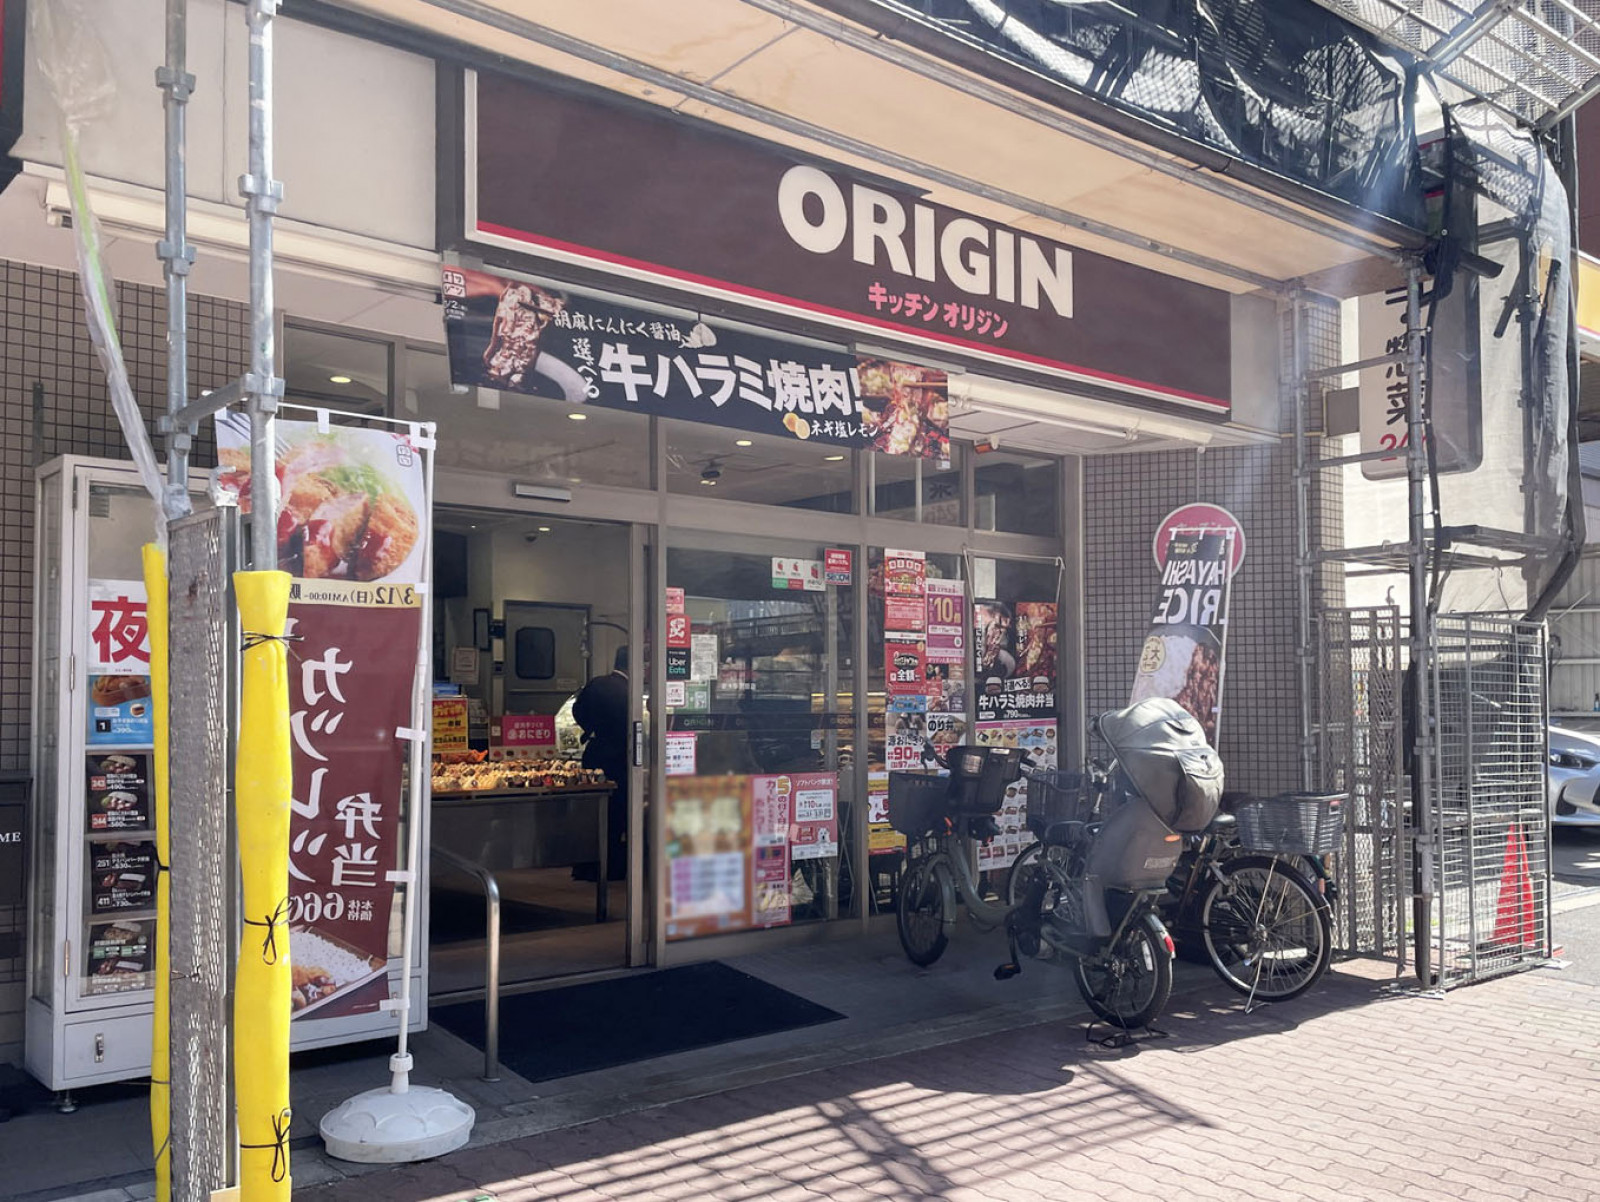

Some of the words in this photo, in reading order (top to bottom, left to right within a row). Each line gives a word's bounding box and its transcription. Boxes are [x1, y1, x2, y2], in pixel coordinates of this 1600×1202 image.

[778, 164, 1073, 319] ORIGIN
[868, 281, 939, 322] キッチン
[943, 302, 1009, 339] オリジン
[552, 312, 682, 342] 胡麻にんにく醤油
[598, 342, 864, 416] 牛ハラミ焼肉!
[810, 419, 879, 439] ネギ塩レモン
[91, 595, 151, 664] 夜
[668, 657, 687, 666] Uber
[668, 666, 687, 675] Eats
[978, 694, 1055, 710] 牛ハラミ焼肉弁当
